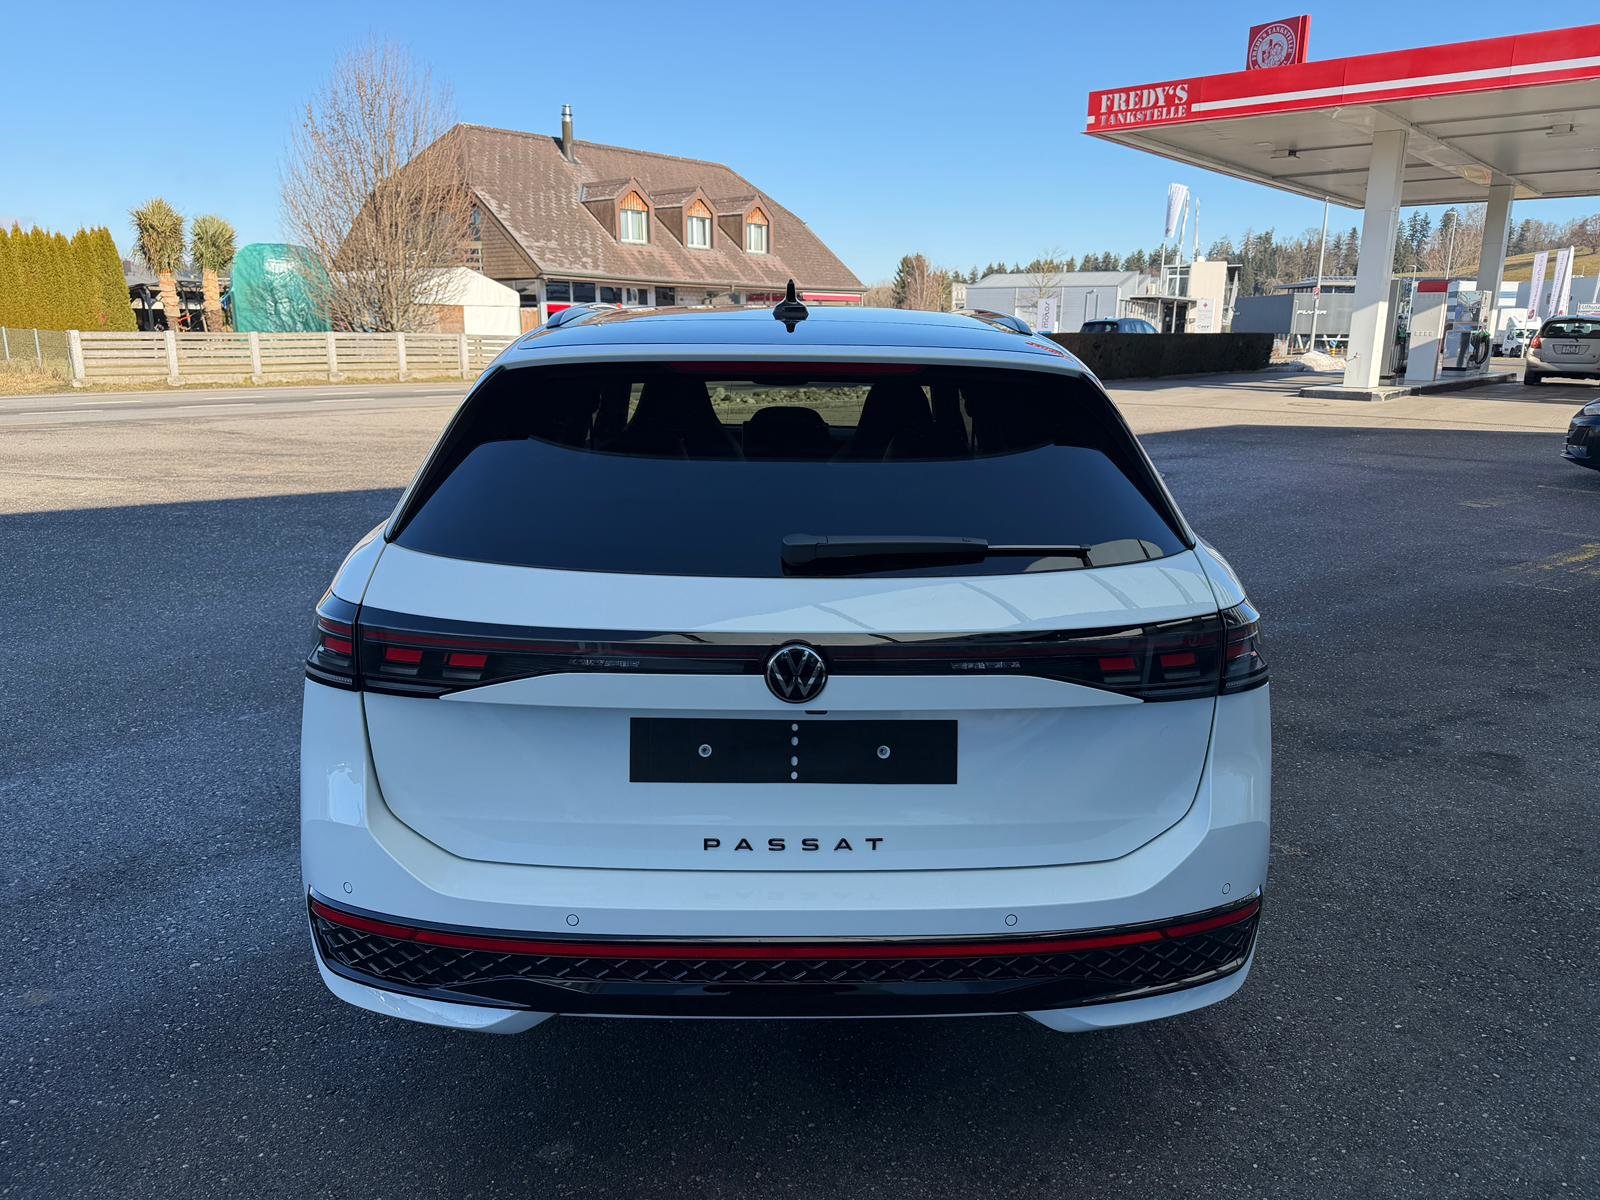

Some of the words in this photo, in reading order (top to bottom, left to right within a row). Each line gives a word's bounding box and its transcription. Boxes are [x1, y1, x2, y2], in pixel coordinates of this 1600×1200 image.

[1100, 84, 1189, 113] FREDY'S
[1101, 105, 1187, 127] TANKSTELLE
[767, 645, 826, 702] VW
[703, 837, 884, 852] PASSAT
